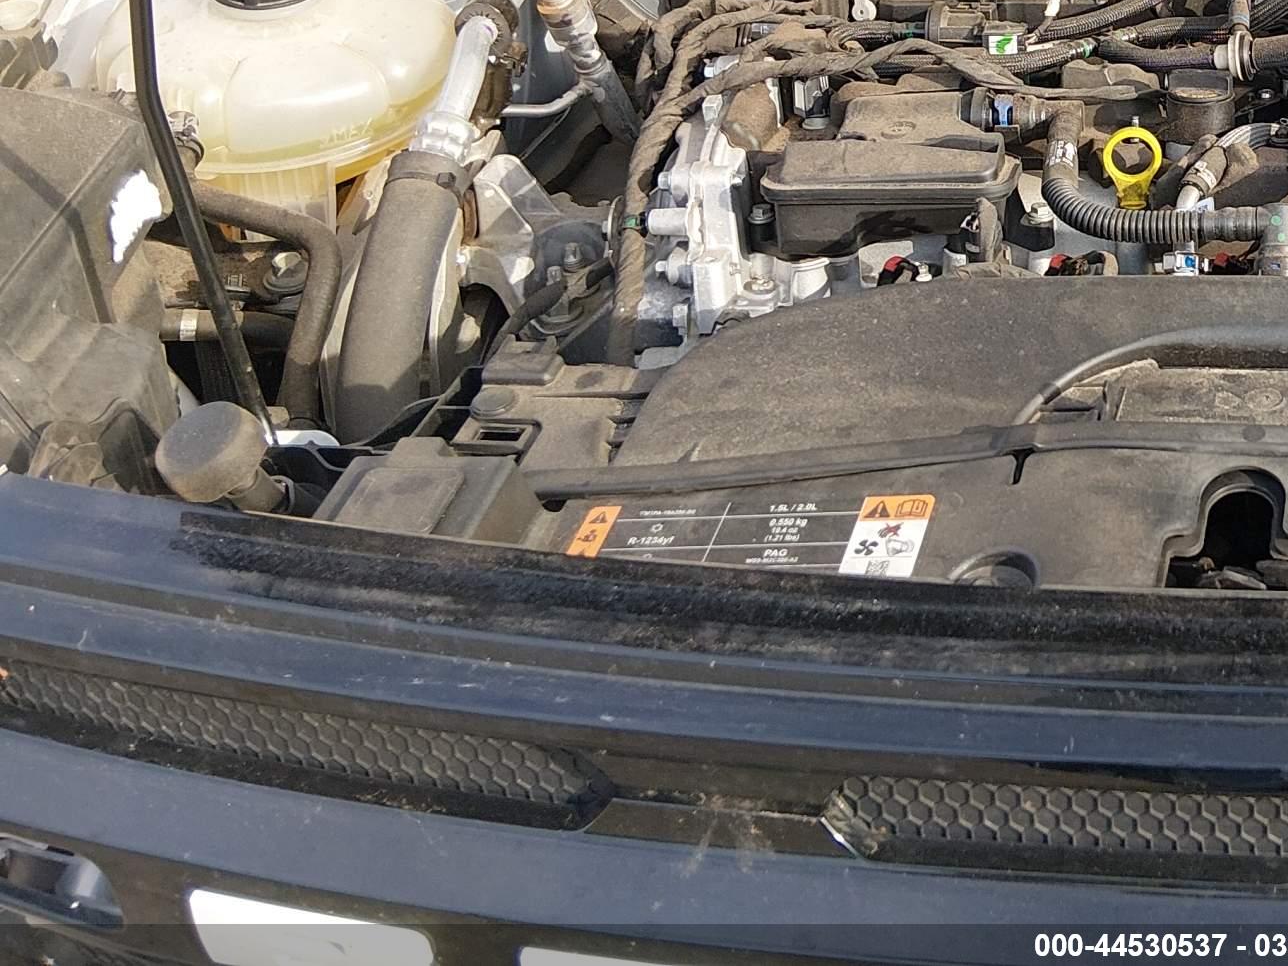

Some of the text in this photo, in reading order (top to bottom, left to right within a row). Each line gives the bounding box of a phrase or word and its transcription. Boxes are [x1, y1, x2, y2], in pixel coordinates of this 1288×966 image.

[770, 504, 789, 512] 1.5L
[797, 503, 817, 511] 2.0L
[796, 517, 808, 527] kg
[763, 549, 788, 557] PAG
